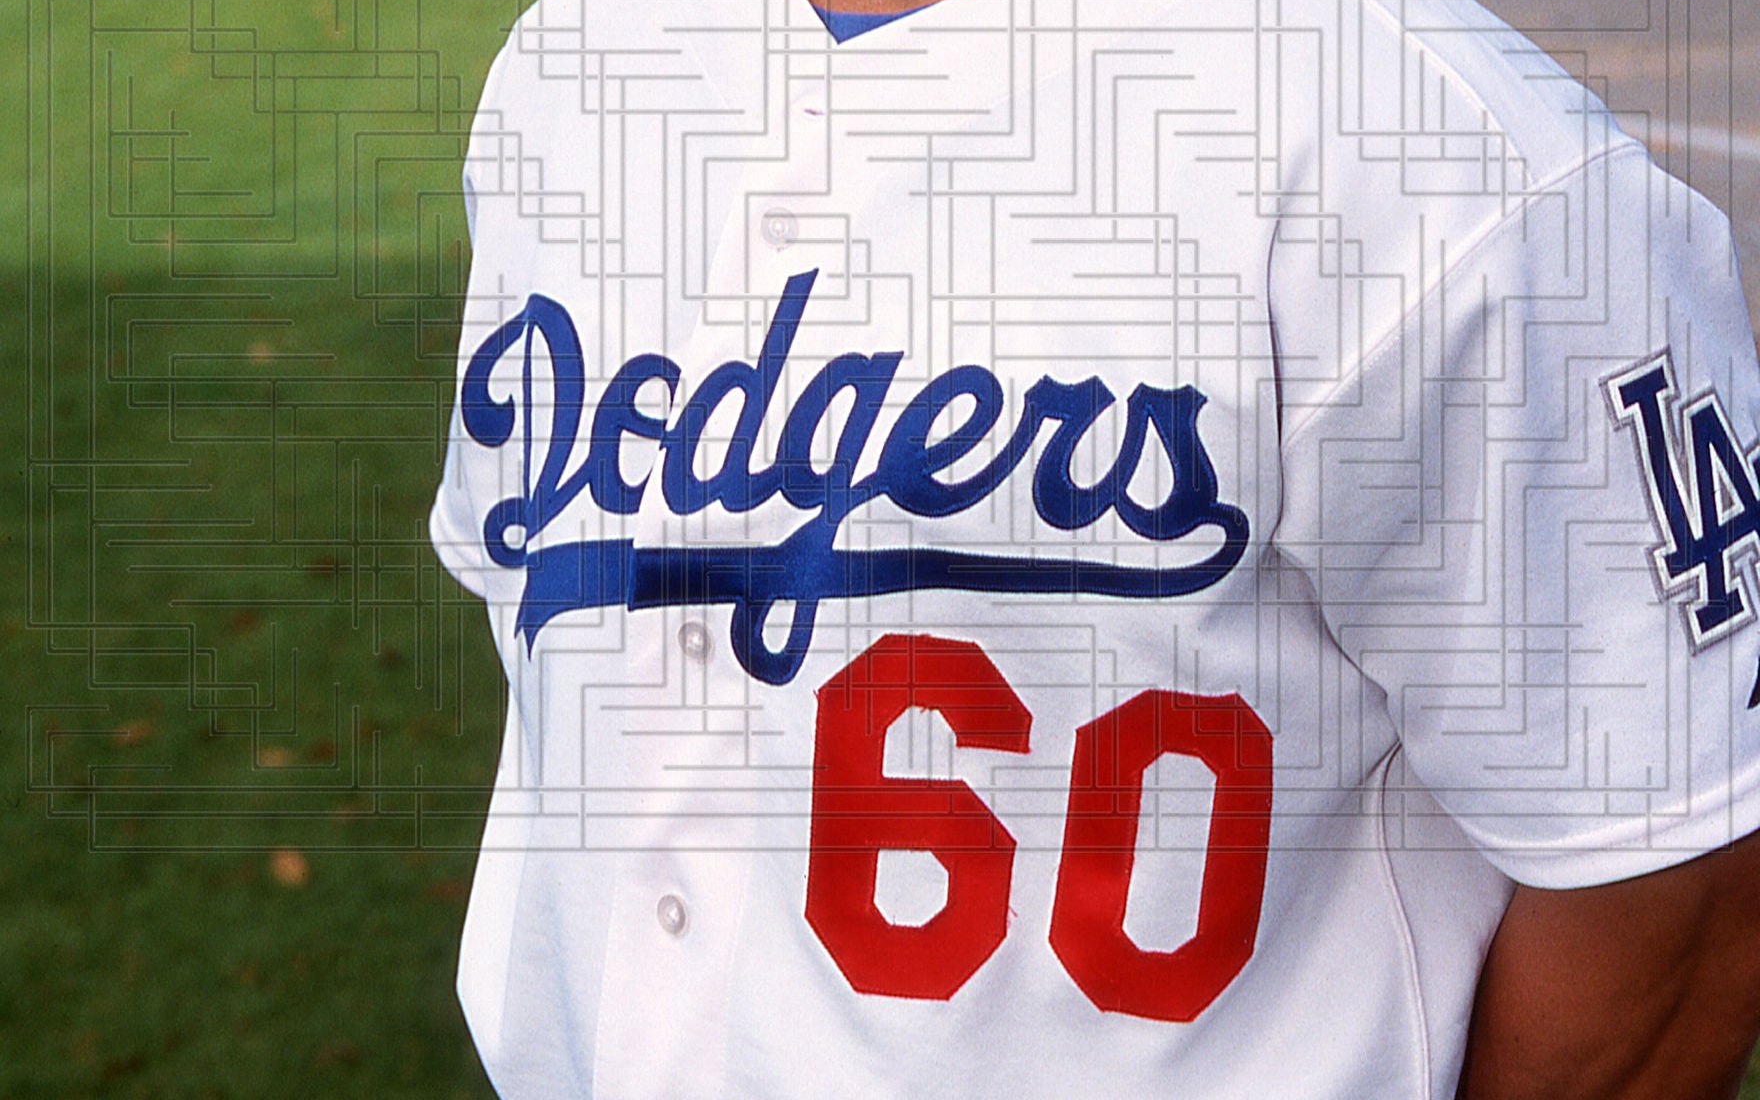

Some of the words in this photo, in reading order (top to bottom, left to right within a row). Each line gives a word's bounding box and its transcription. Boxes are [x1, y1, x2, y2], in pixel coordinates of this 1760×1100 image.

[461, 267, 1250, 686] Dodgers
[1599, 344, 1760, 657] LA
[804, 633, 1274, 1023] 60
